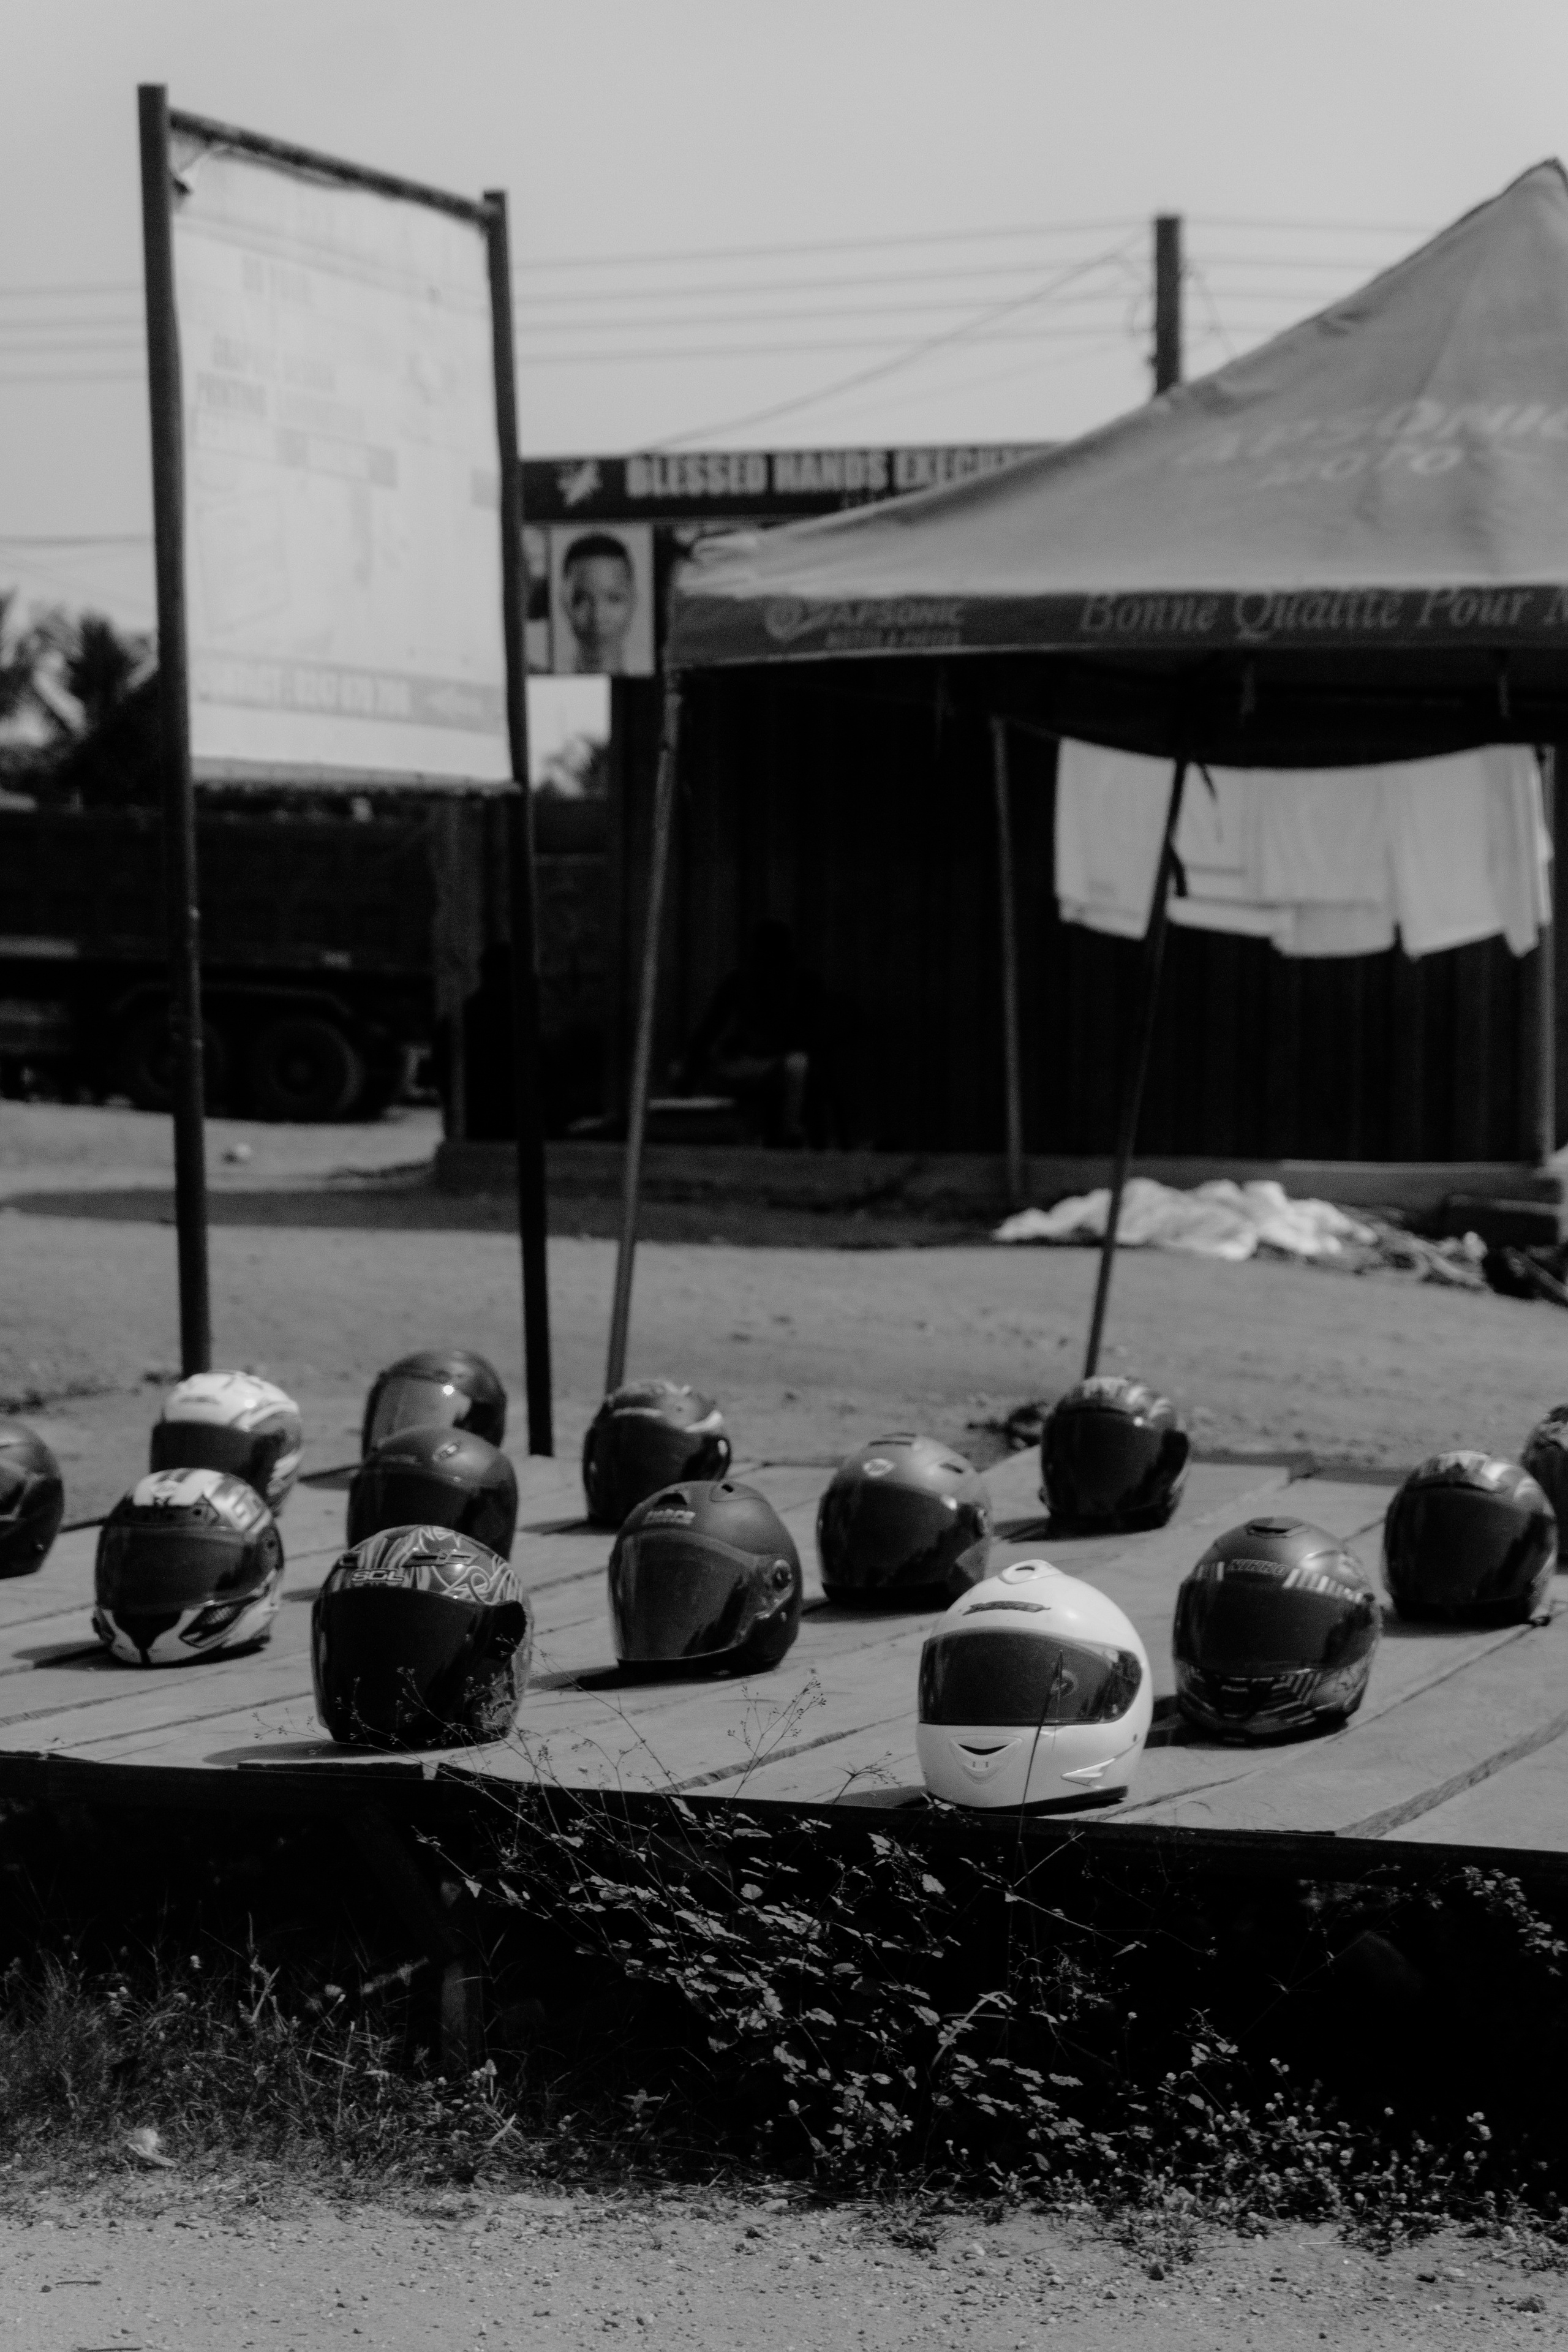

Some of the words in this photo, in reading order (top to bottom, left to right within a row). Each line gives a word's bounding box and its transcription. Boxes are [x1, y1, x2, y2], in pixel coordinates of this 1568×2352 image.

[625, 454, 768, 499] BLESSED
[772, 450, 888, 492] HANDS
[1079, 593, 1219, 632] Bonne
[1415, 586, 1535, 627] Pour
